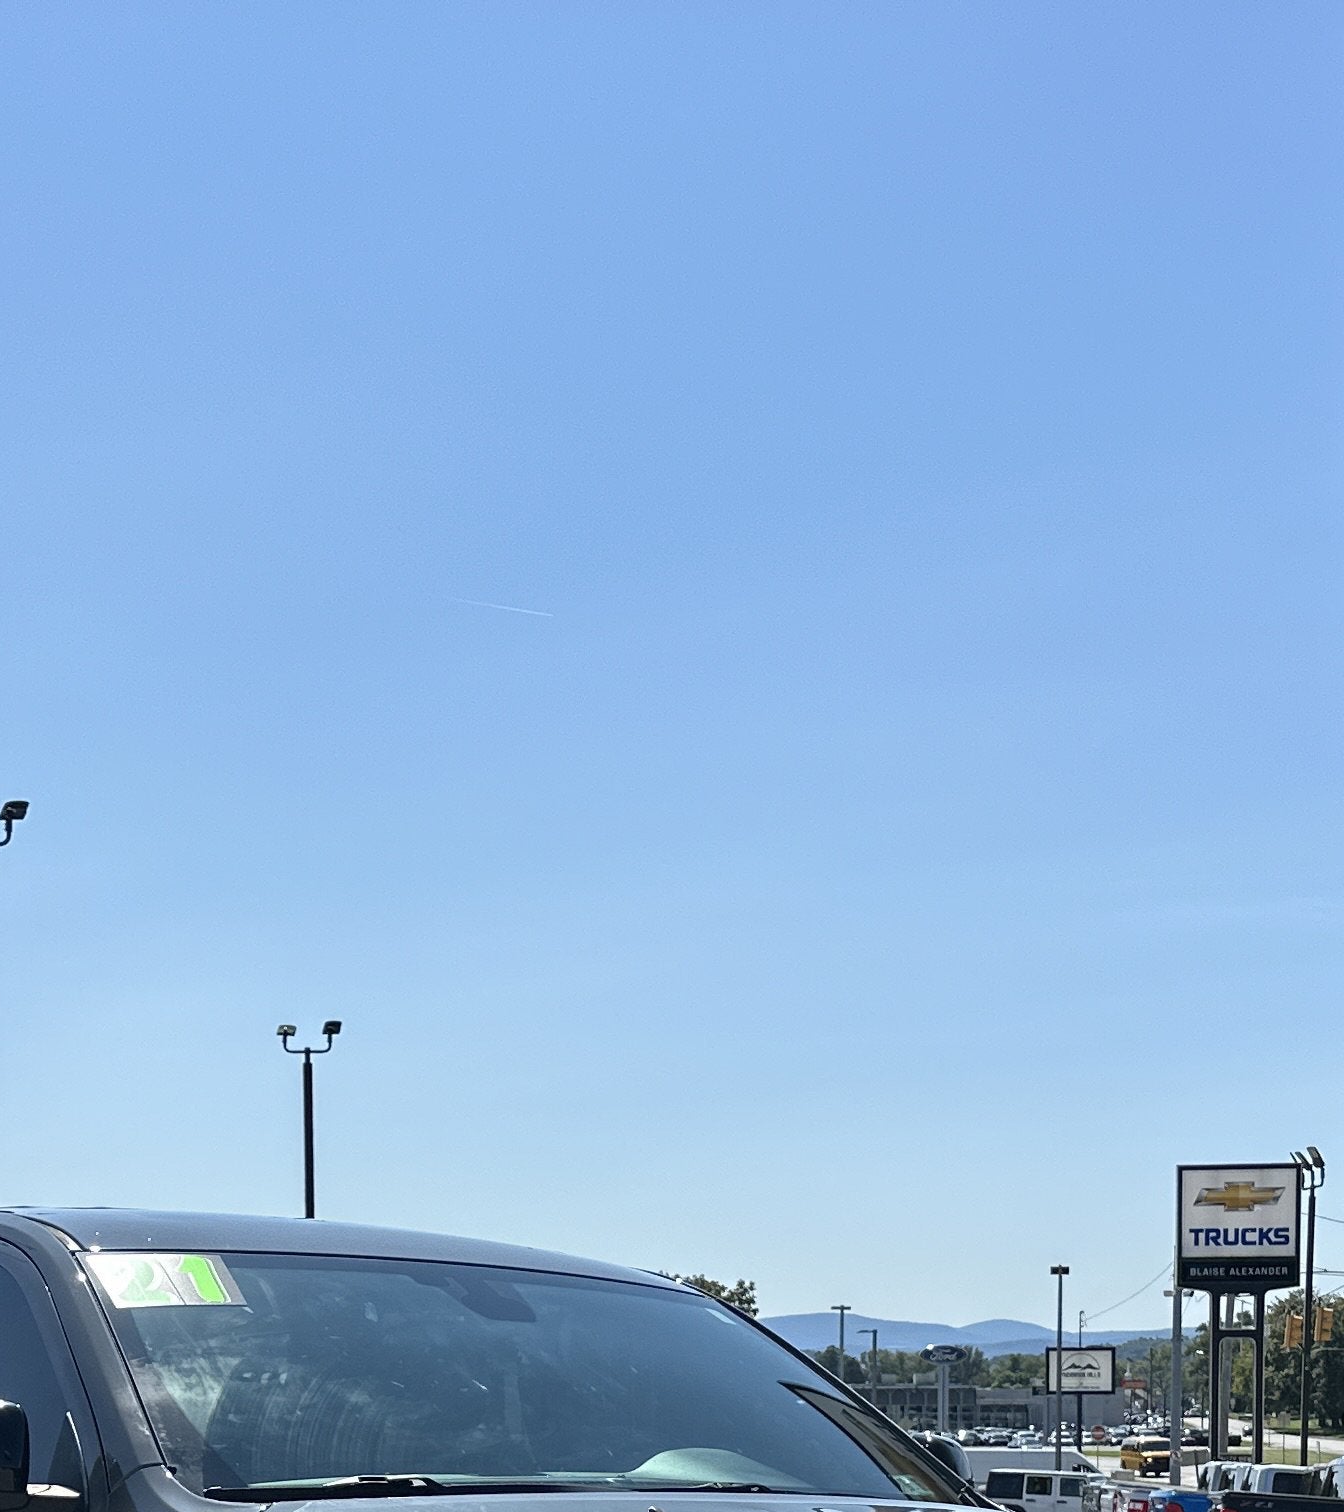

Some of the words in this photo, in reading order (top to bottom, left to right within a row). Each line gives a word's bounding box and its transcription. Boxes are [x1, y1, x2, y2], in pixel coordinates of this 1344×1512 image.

[1189, 1227, 1290, 1246] TRUCKS
[116, 1254, 231, 1304] 21
[1189, 1267, 1225, 1277] BLAISE
[1229, 1266, 1288, 1276] ALEXANDER
